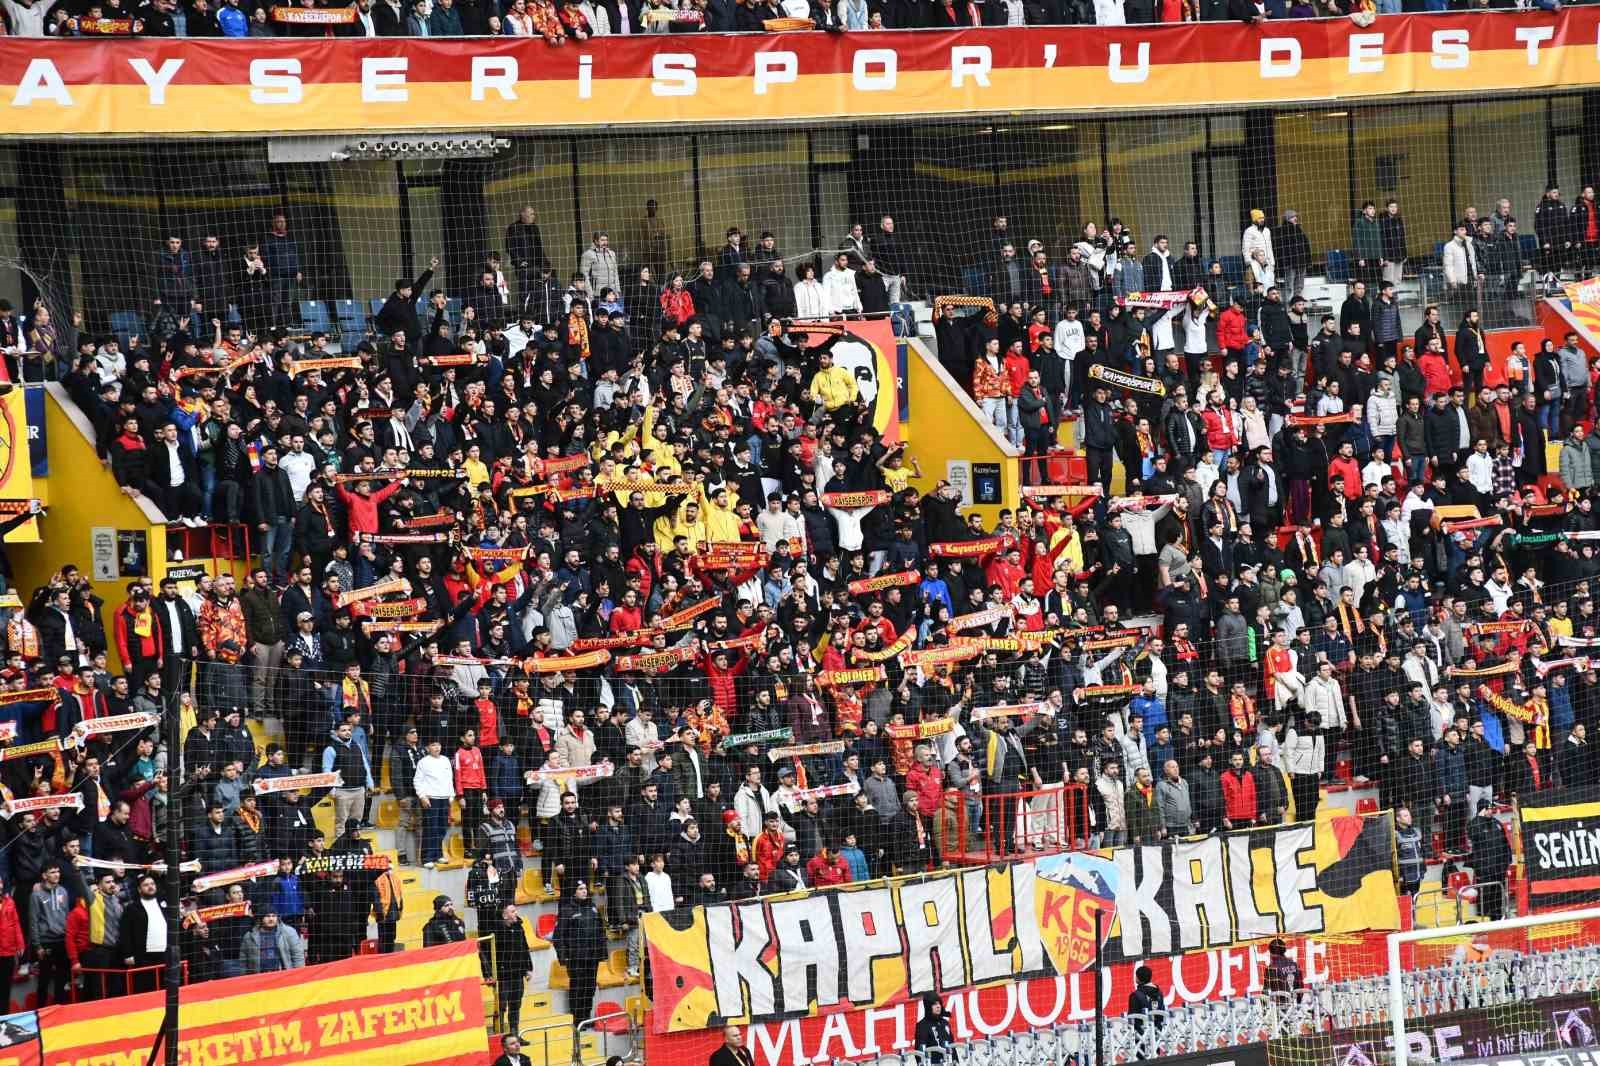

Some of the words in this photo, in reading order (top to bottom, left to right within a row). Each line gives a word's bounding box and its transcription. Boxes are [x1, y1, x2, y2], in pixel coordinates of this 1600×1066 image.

[1260, 23, 1600, 78] DEST
[1112, 825, 1326, 957] KALE
[1134, 938, 1330, 1006] OFFE
[317, 988, 465, 1047] ZAFERİM
